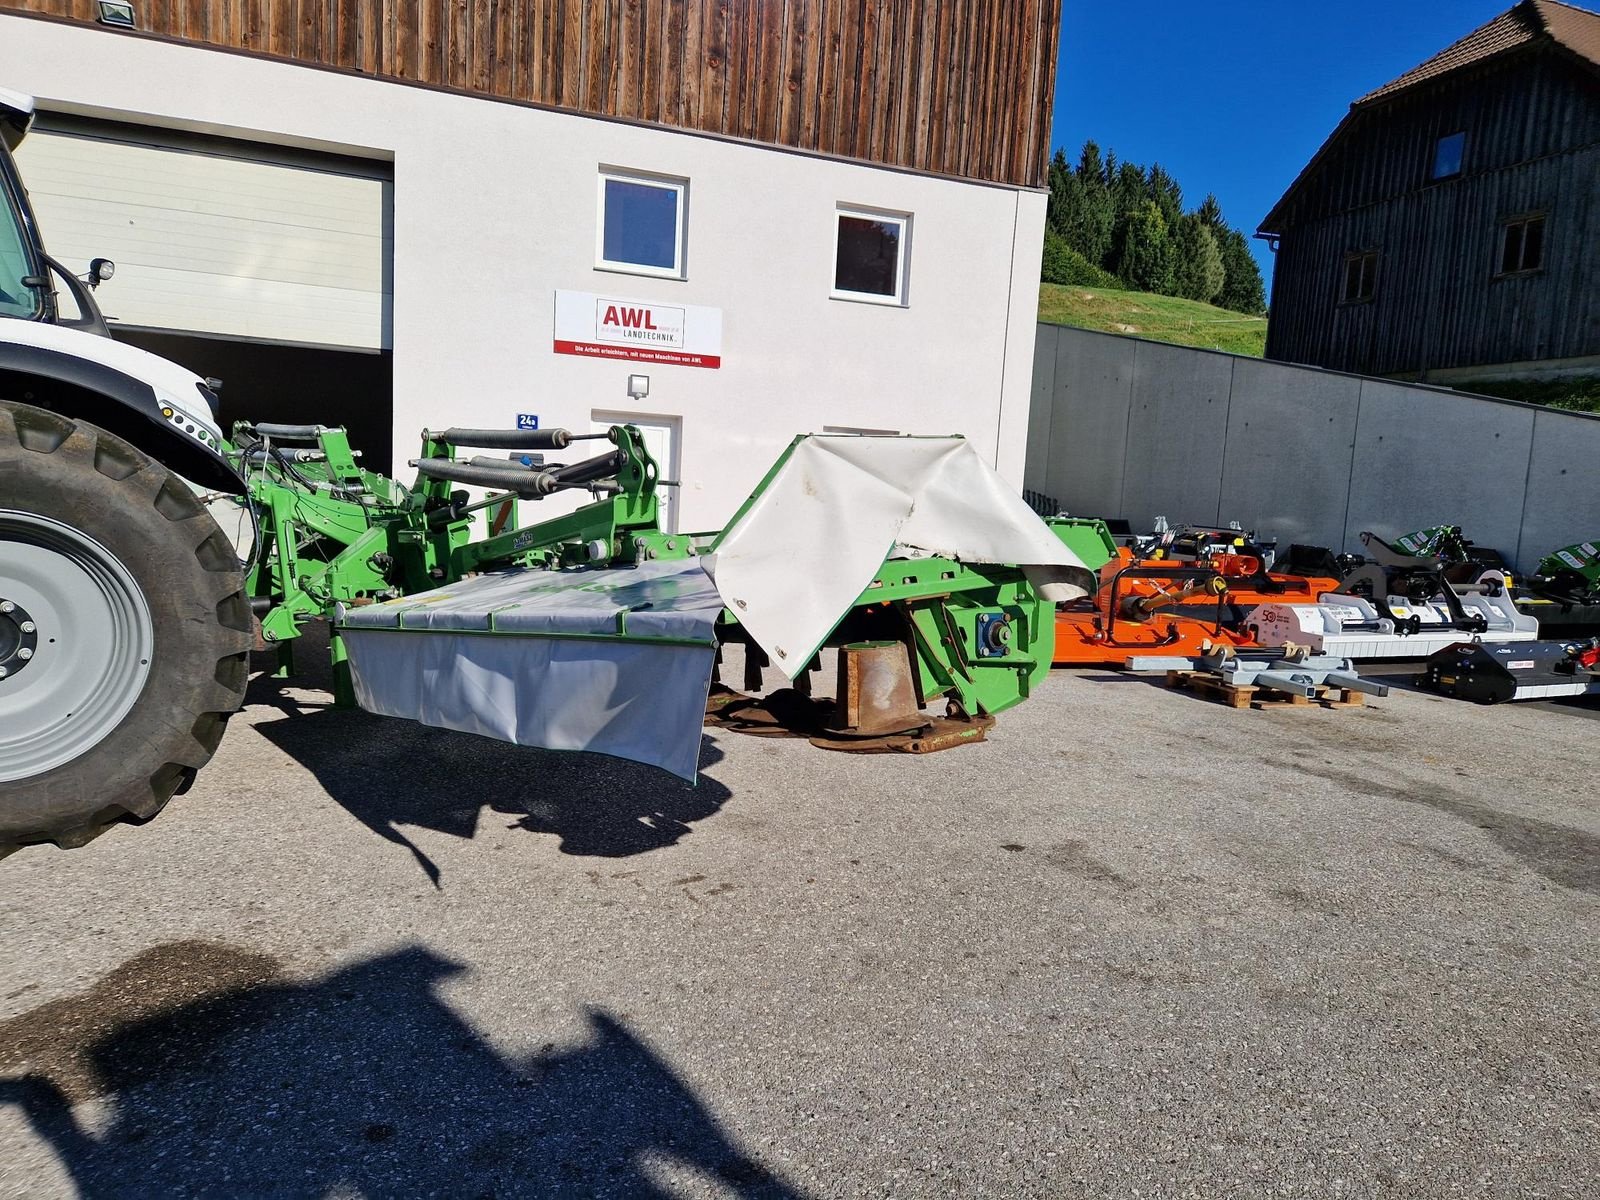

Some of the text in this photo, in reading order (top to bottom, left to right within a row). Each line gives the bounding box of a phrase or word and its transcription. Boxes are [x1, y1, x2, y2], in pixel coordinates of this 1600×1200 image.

[603, 306, 657, 330] AWL
[584, 346, 600, 354] Arbeit
[601, 348, 629, 357] erleichtern,
[655, 353, 681, 361] Maschinen
